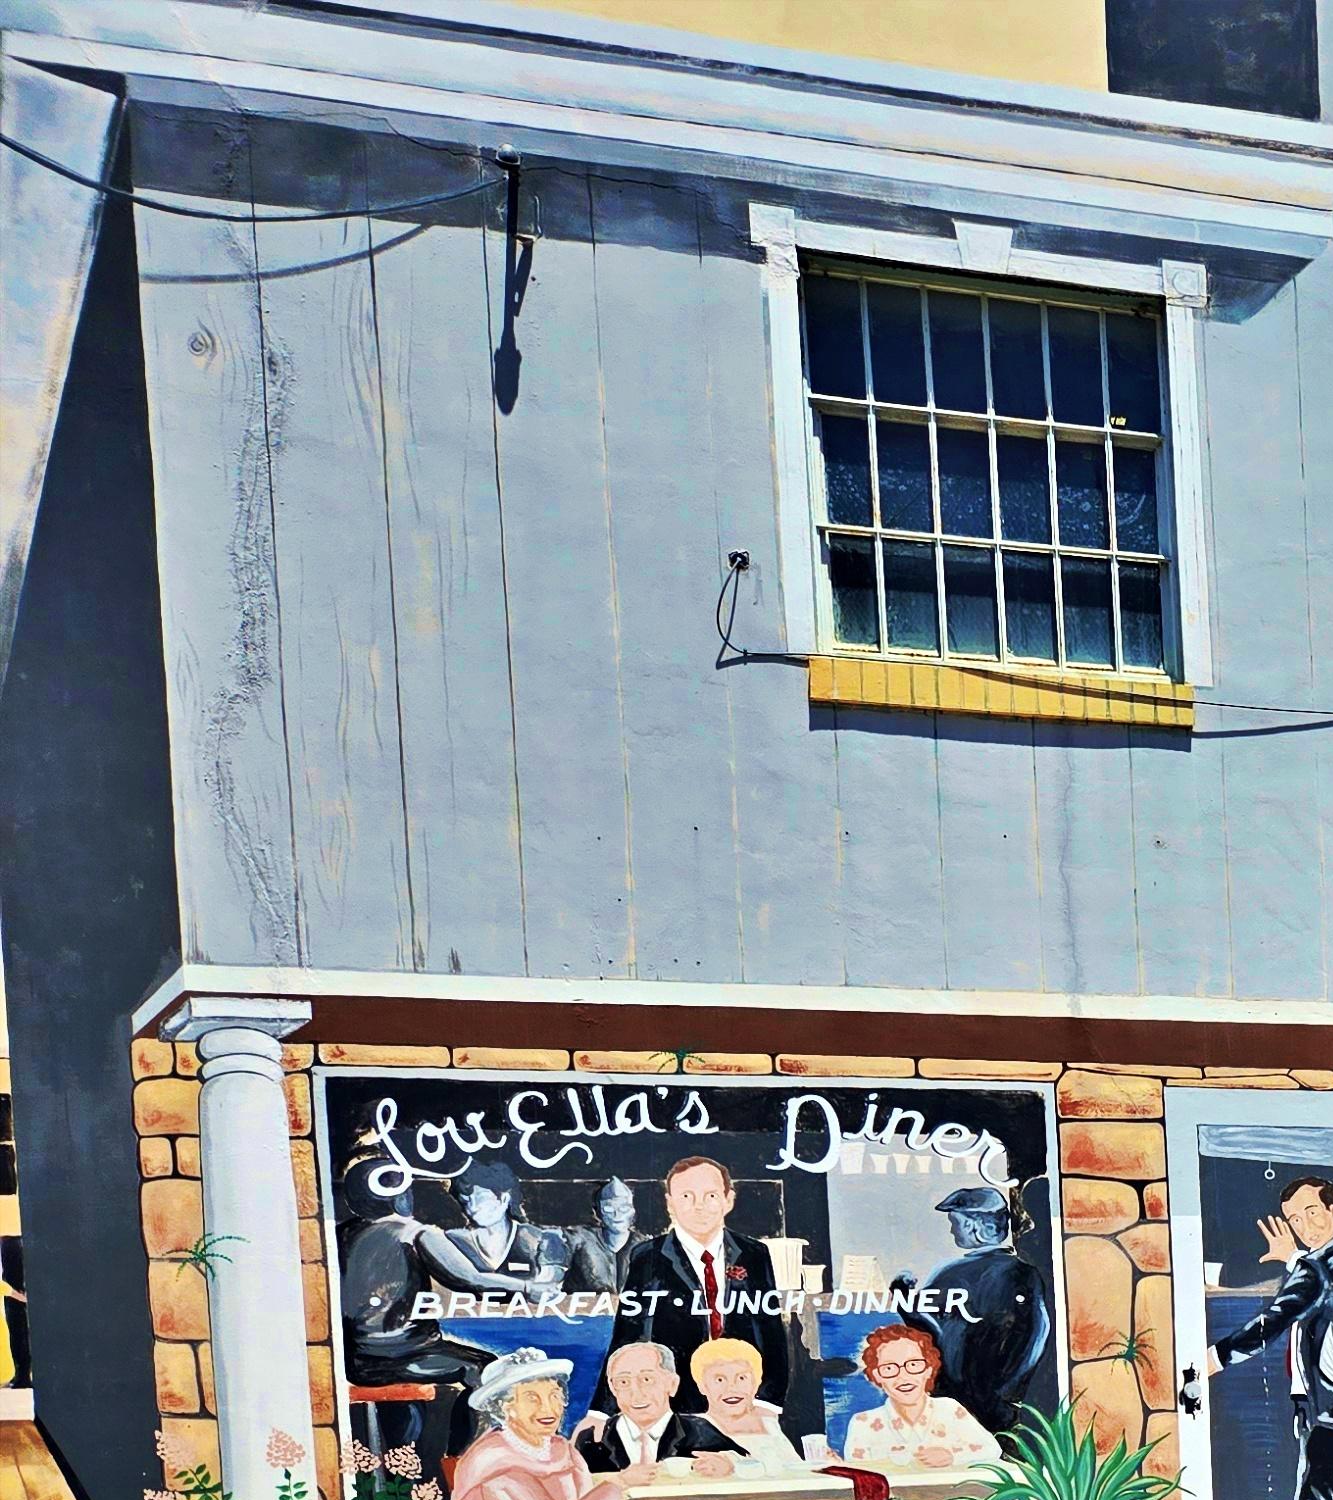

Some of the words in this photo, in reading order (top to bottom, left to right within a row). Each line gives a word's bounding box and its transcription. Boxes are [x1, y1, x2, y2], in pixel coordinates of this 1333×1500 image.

[508, 1084, 720, 1169] Ella's
[766, 1093, 1020, 1188] Diner
[411, 1290, 668, 1324] BREAKFAST
[689, 1288, 805, 1318] LUNCH
[830, 1288, 983, 1323] DINNER
